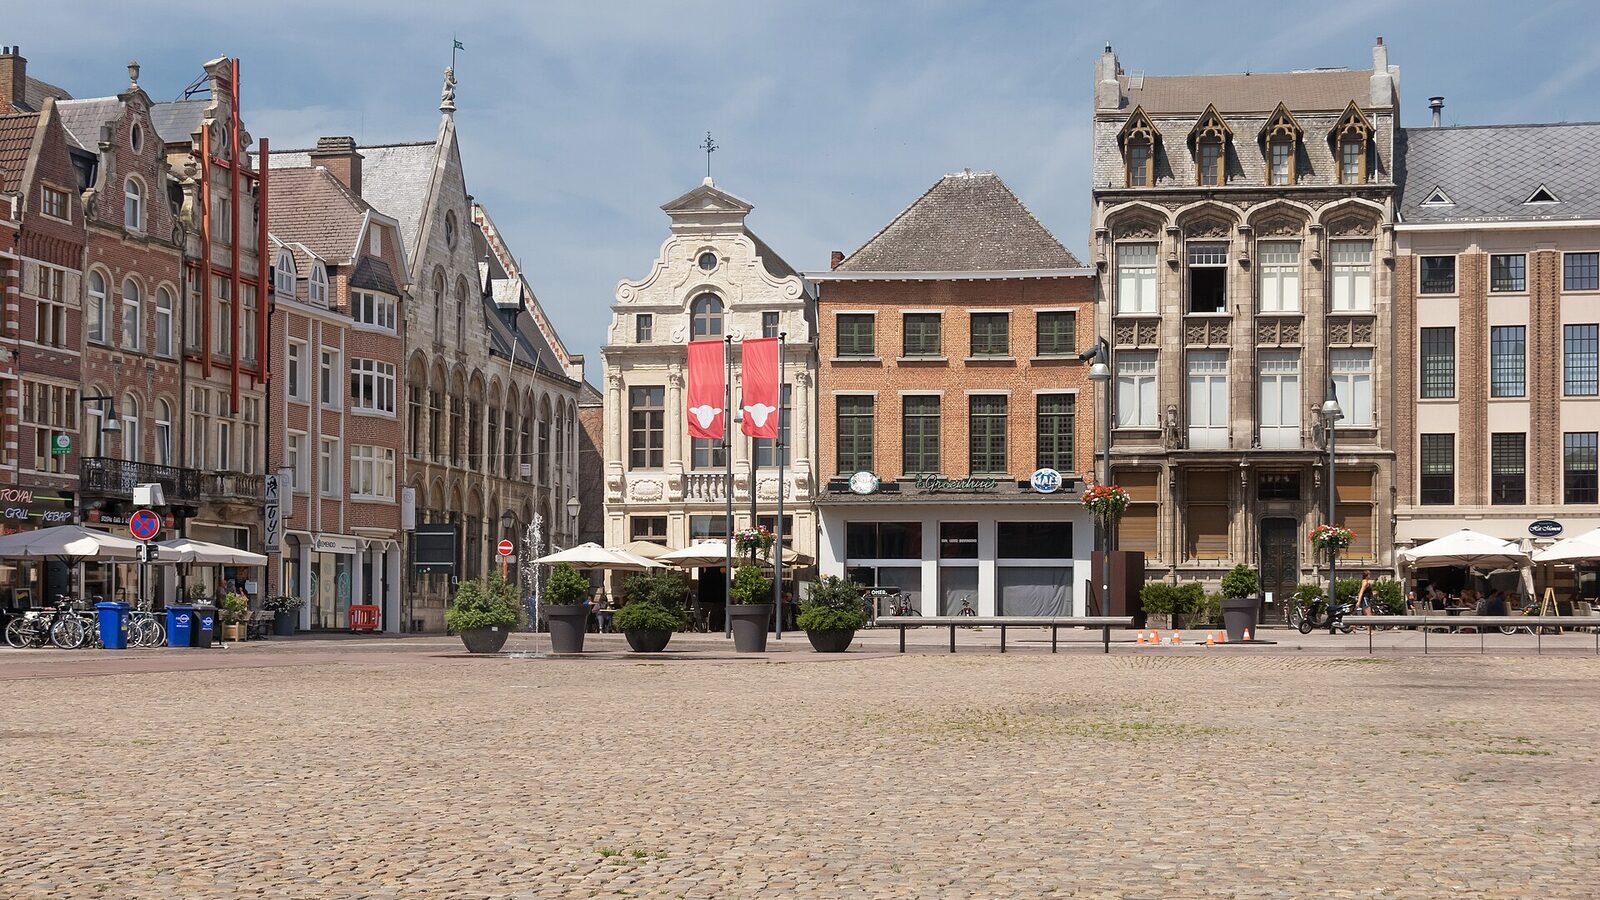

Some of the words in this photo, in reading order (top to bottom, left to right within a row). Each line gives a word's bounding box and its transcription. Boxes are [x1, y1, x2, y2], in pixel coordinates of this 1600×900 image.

[925, 473, 998, 491] Groenhuis
[0, 488, 33, 503] ROYAL
[5, 507, 28, 520] GRILL
